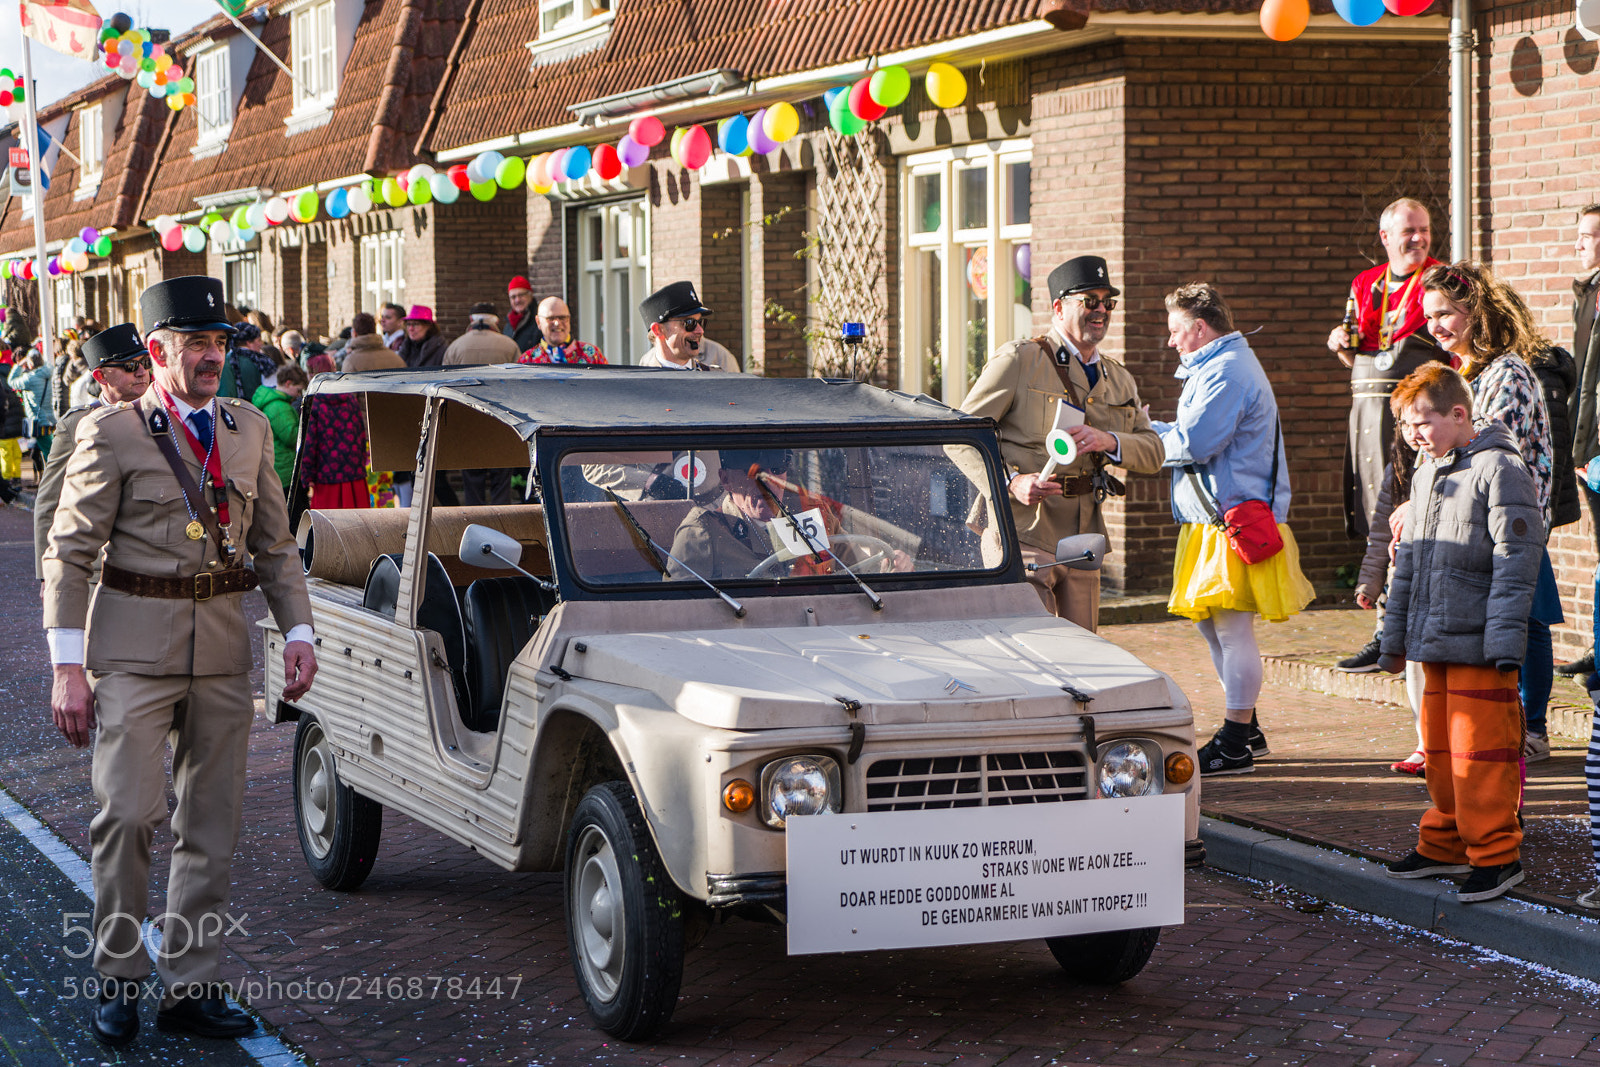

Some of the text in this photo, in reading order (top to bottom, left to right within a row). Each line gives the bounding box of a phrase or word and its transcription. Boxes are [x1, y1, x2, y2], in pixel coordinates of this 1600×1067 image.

[785, 516, 818, 543] 75
[840, 839, 1037, 865] UT WURDT IN KUUK ZO WERRUM,
[982, 852, 1147, 878] STRAKS WONE WE AON ZEE....
[840, 882, 1015, 907] DOAR HEDDE GODDOMME AL
[922, 910, 938, 926] DE
[941, 904, 1028, 924] GENDARMERIE
[1031, 901, 1053, 918] VAN
[1057, 898, 1089, 915] SAINT
[1091, 894, 1133, 911] TROPEZ
